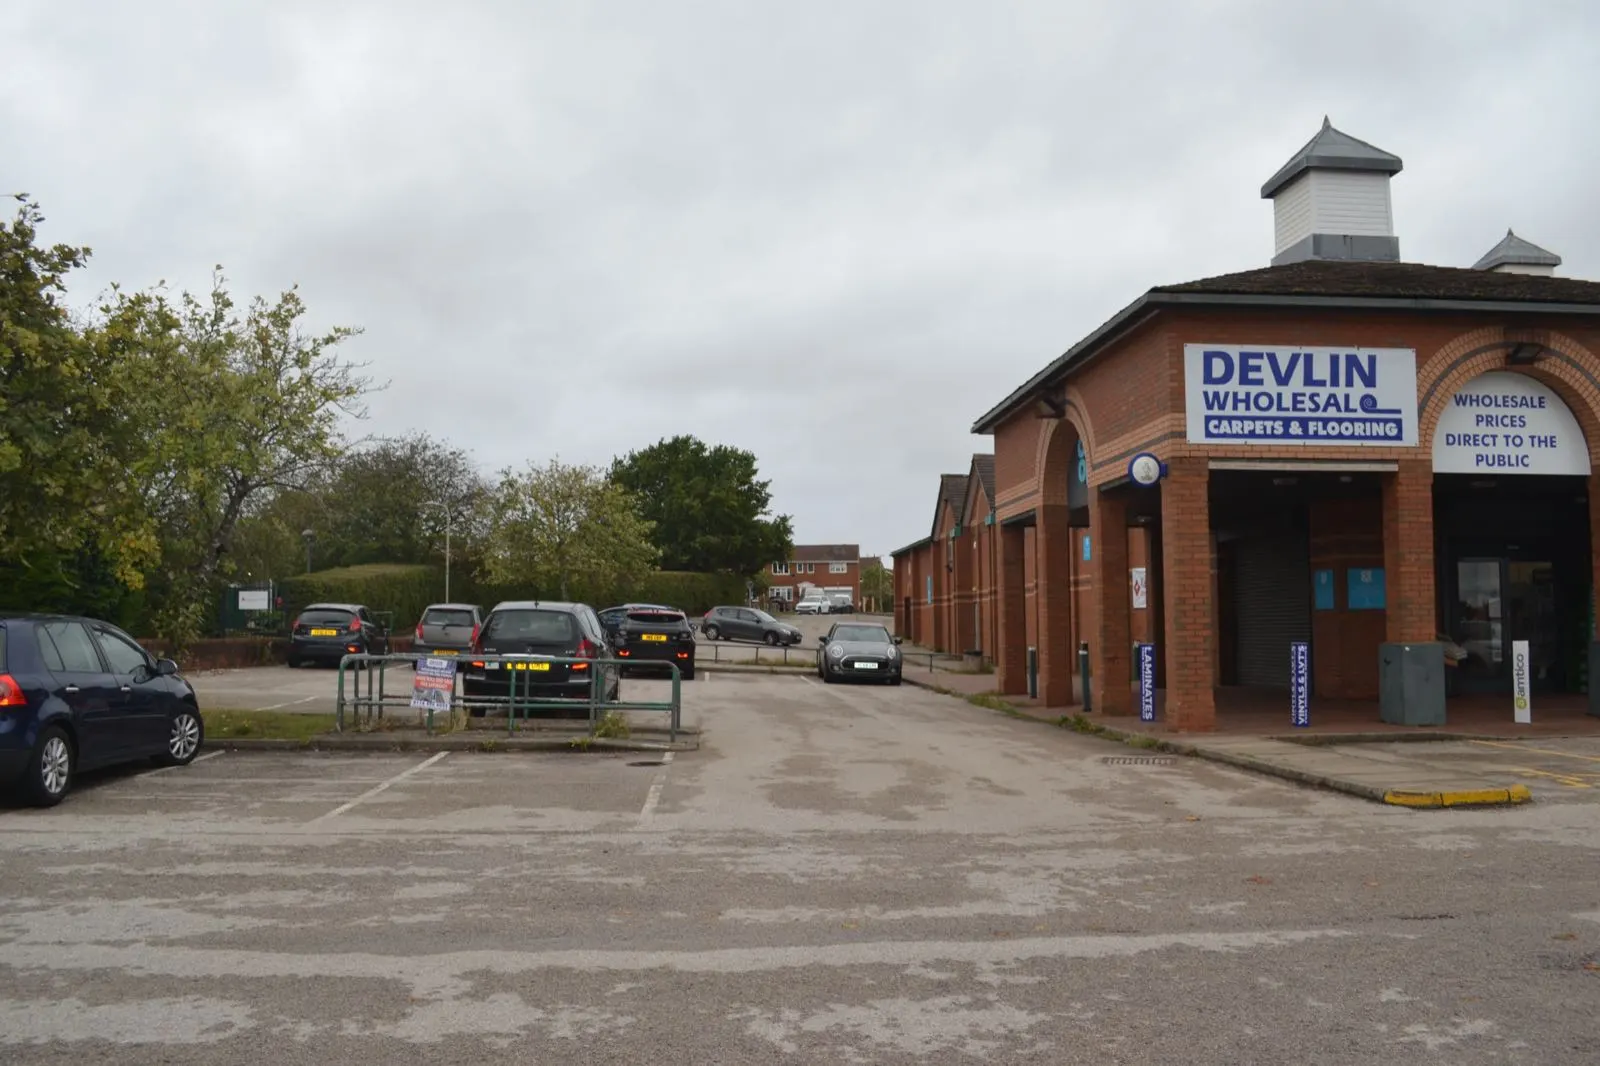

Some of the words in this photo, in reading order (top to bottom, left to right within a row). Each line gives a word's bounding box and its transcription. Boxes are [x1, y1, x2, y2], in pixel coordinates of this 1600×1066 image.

[1203, 351, 1376, 388] DEVLIN
[1454, 394, 1546, 409] WHOLESALE
[1208, 419, 1284, 436] CARPETS
[1289, 420, 1304, 436] &
[1308, 421, 1398, 437] FLOORING
[1475, 414, 1526, 428] PRICES
[1445, 433, 1498, 447] DIRECT
[1503, 434, 1524, 448] TO
[1528, 435, 1557, 448] THE
[1475, 454, 1530, 467] PUBLIC
[1144, 646, 1153, 720] LAMINATES
[1515, 653, 1525, 697] amtico
